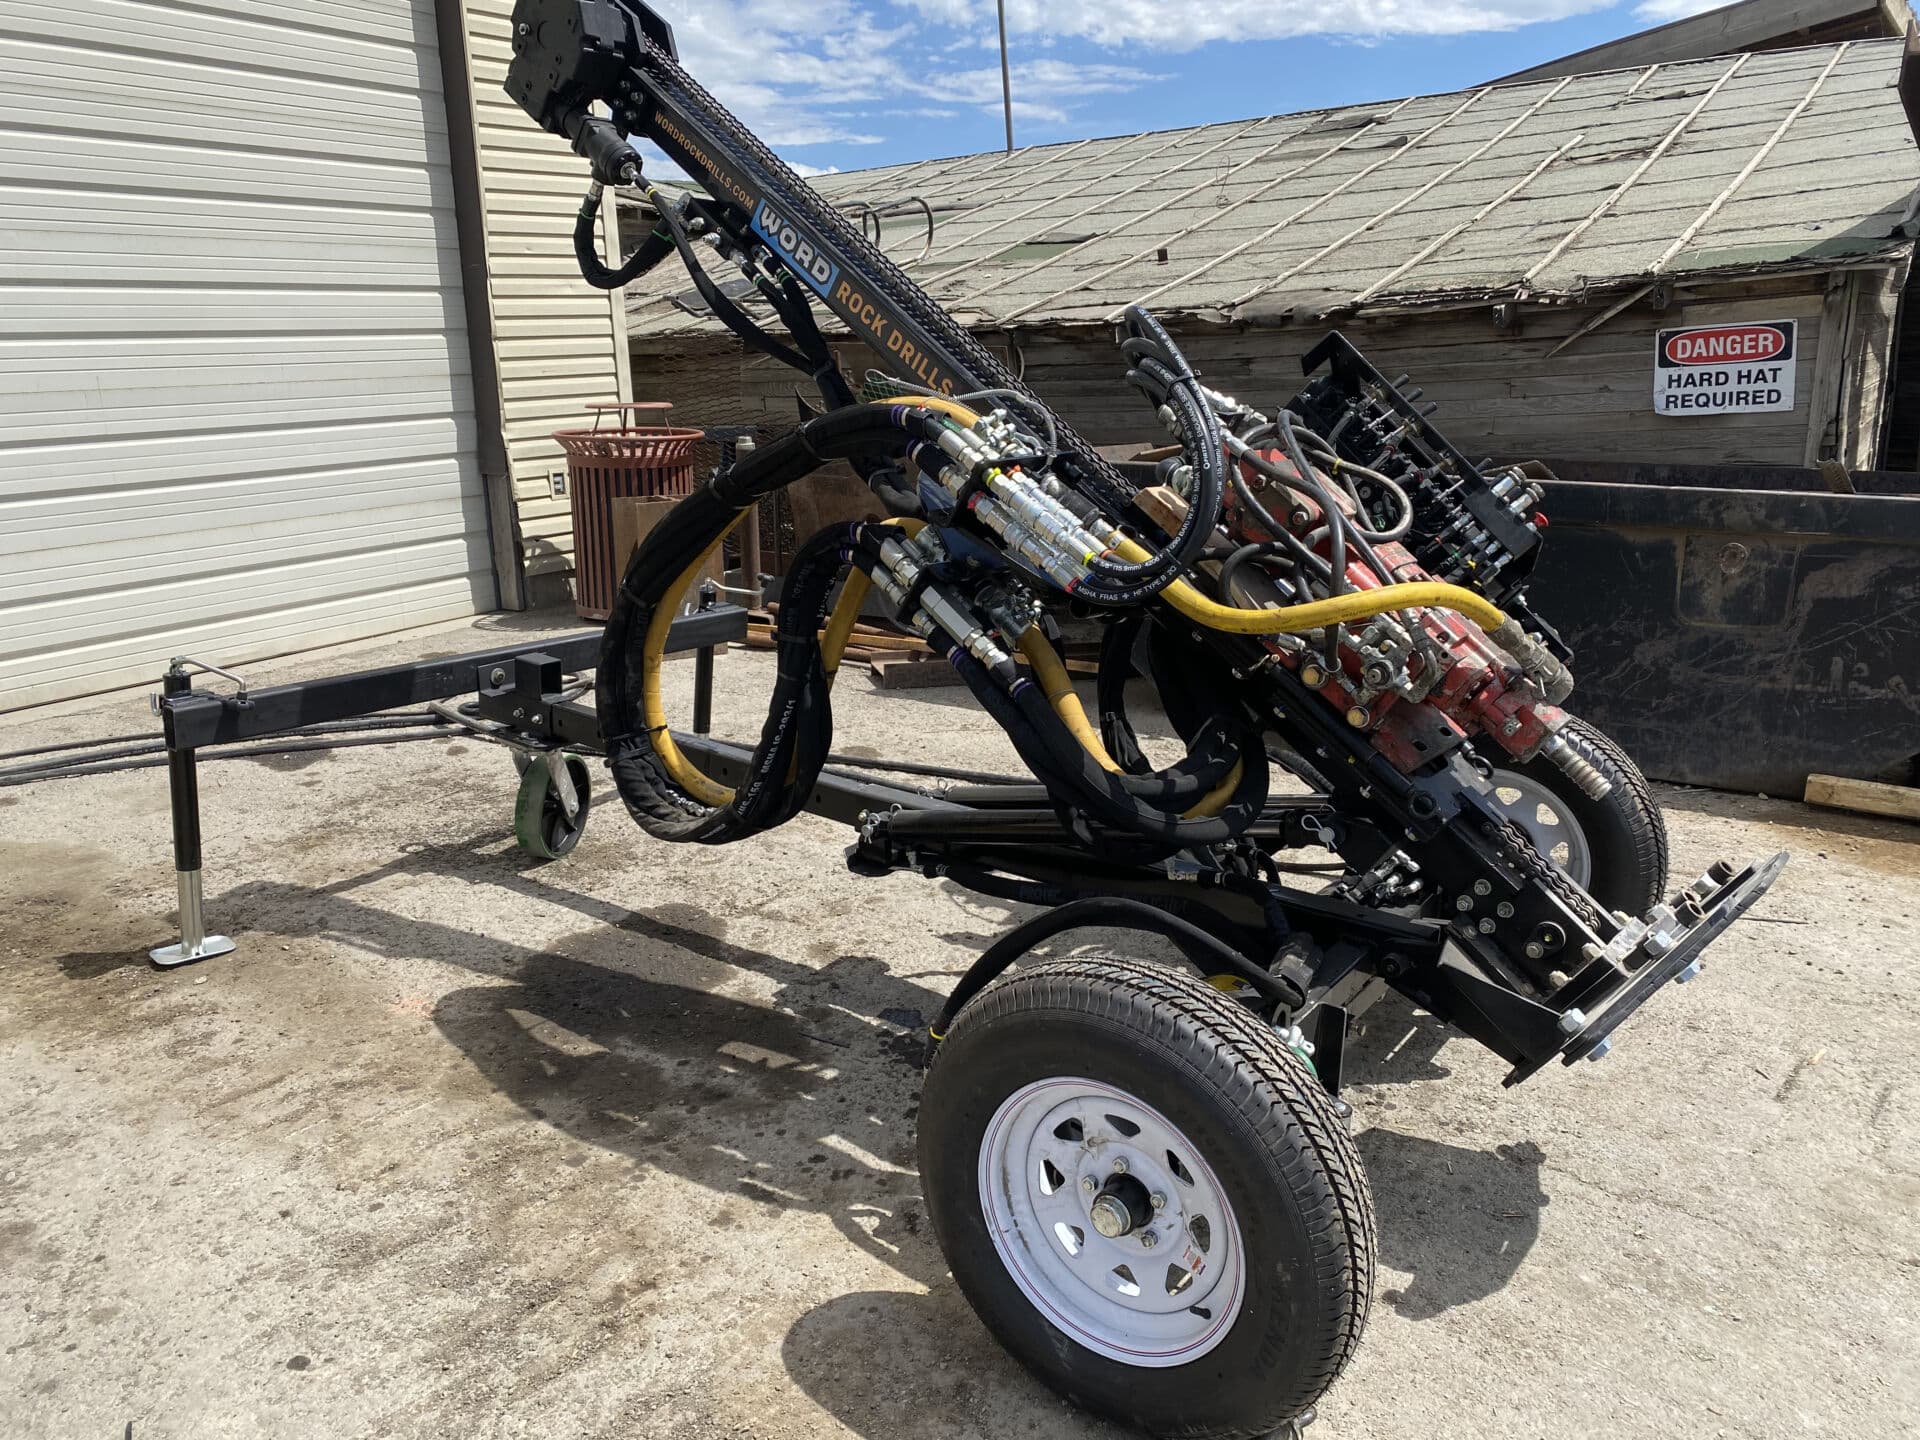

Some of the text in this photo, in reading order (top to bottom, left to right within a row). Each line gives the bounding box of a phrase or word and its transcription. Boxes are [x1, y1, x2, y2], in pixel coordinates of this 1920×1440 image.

[655, 111, 754, 210] WORDROCKDRILLS.COM
[759, 206, 834, 285] WORD
[836, 281, 953, 394] ROCK DRILLS
[1676, 333, 1774, 359] DANGER
[1667, 368, 1782, 389] HARD HAT
[1665, 389, 1782, 409] REQUIRED
[1077, 585, 1097, 599] MSHA
[1099, 593, 1118, 601] FRAS
[1133, 589, 1143, 597] HF
[1144, 579, 1162, 593] TYPE
